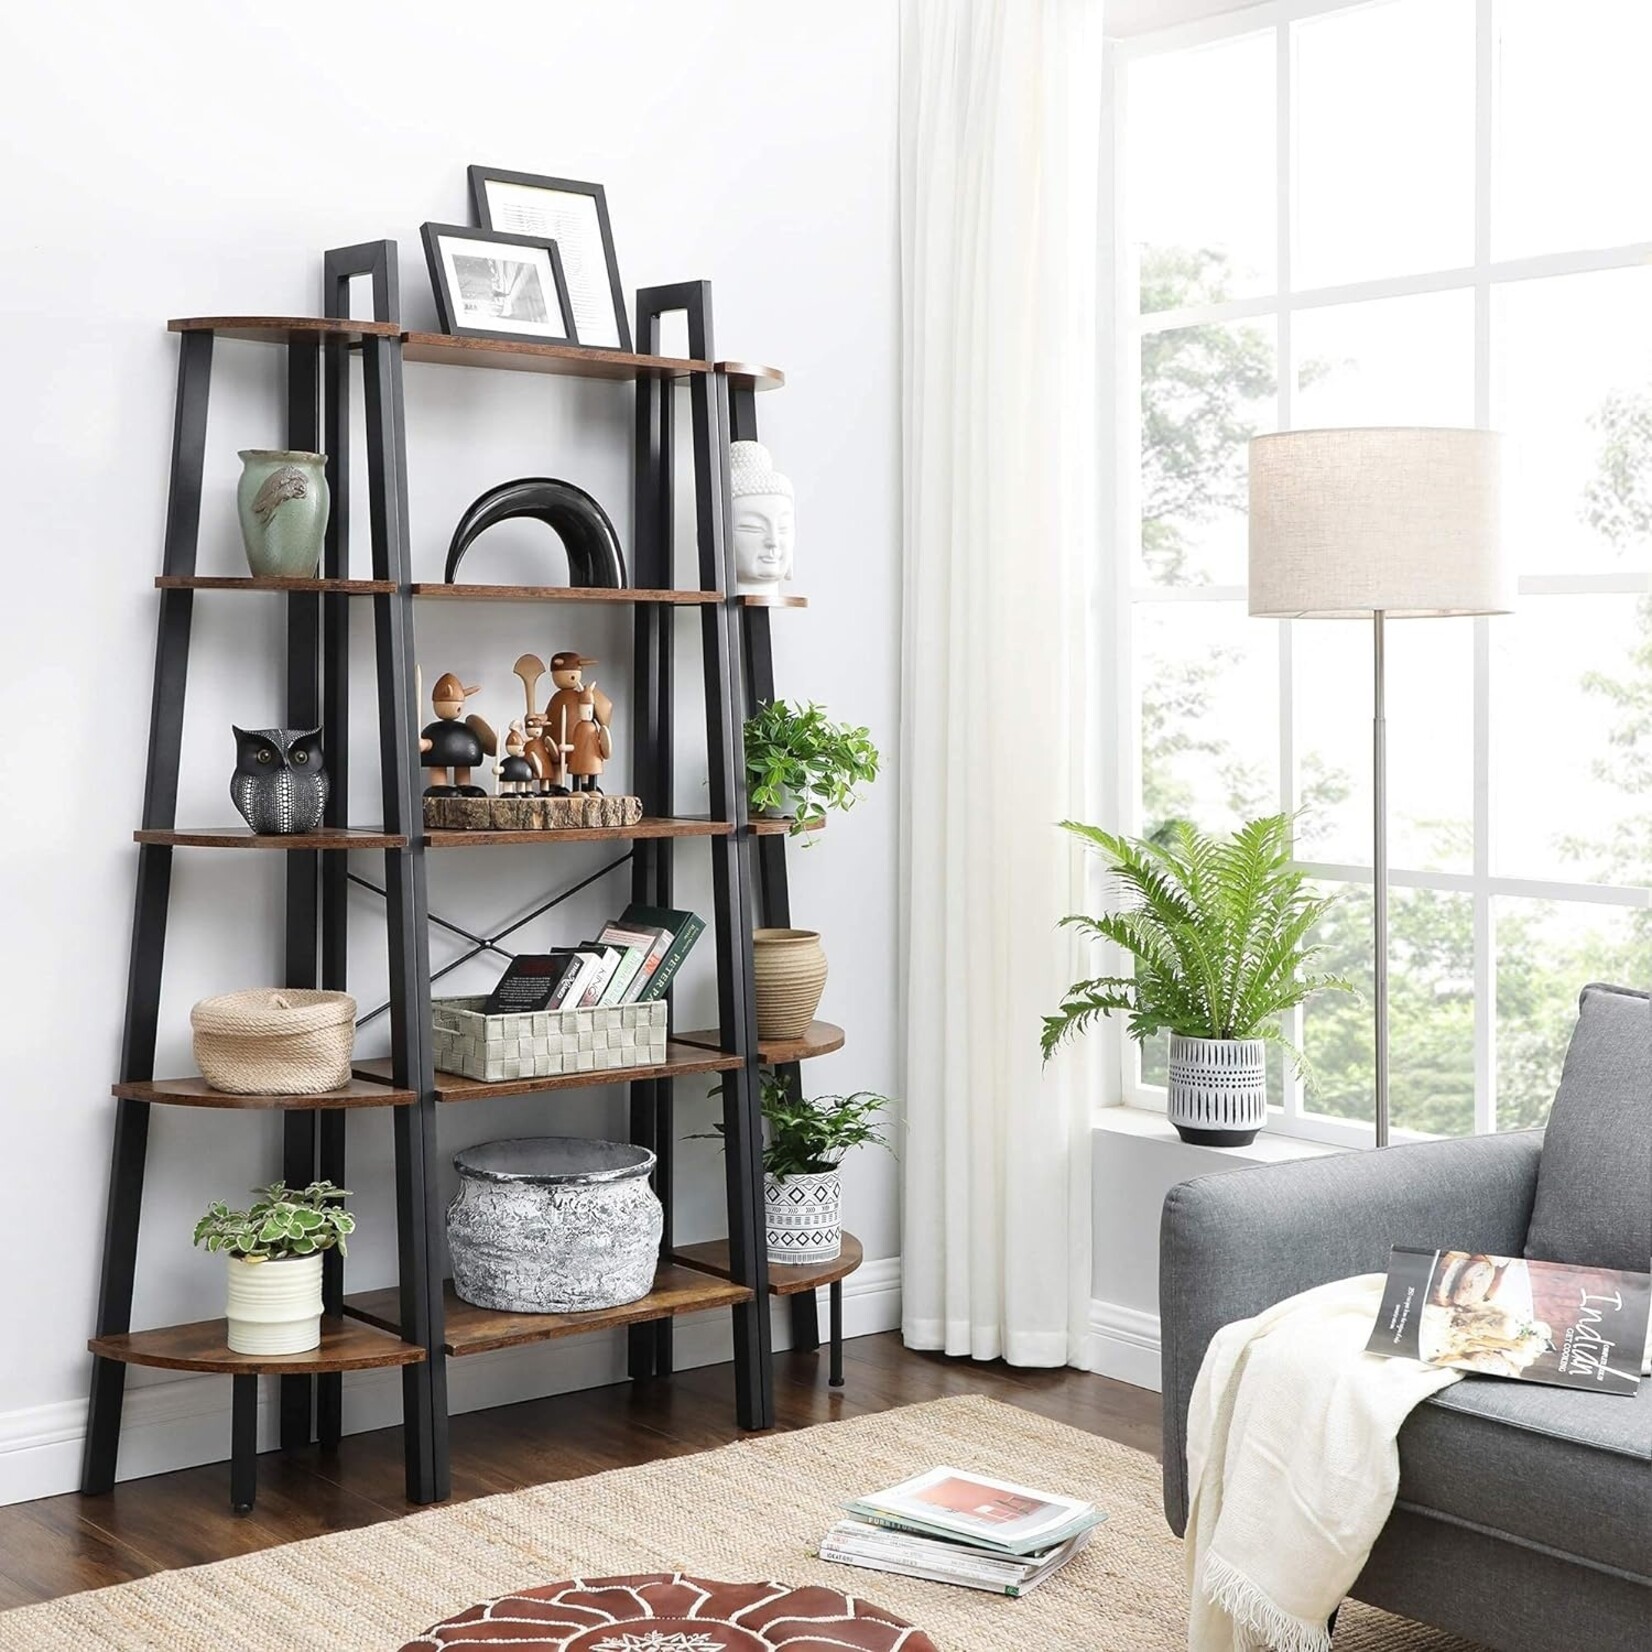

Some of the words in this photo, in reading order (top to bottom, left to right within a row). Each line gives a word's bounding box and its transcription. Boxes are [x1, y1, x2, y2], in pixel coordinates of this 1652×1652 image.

[588, 967, 606, 998] KING
[655, 953, 680, 988] PETER
[1565, 1328, 1574, 1343] GET
[1569, 1288, 1640, 1383] Indian
[1558, 1343, 1571, 1372] COOKING
